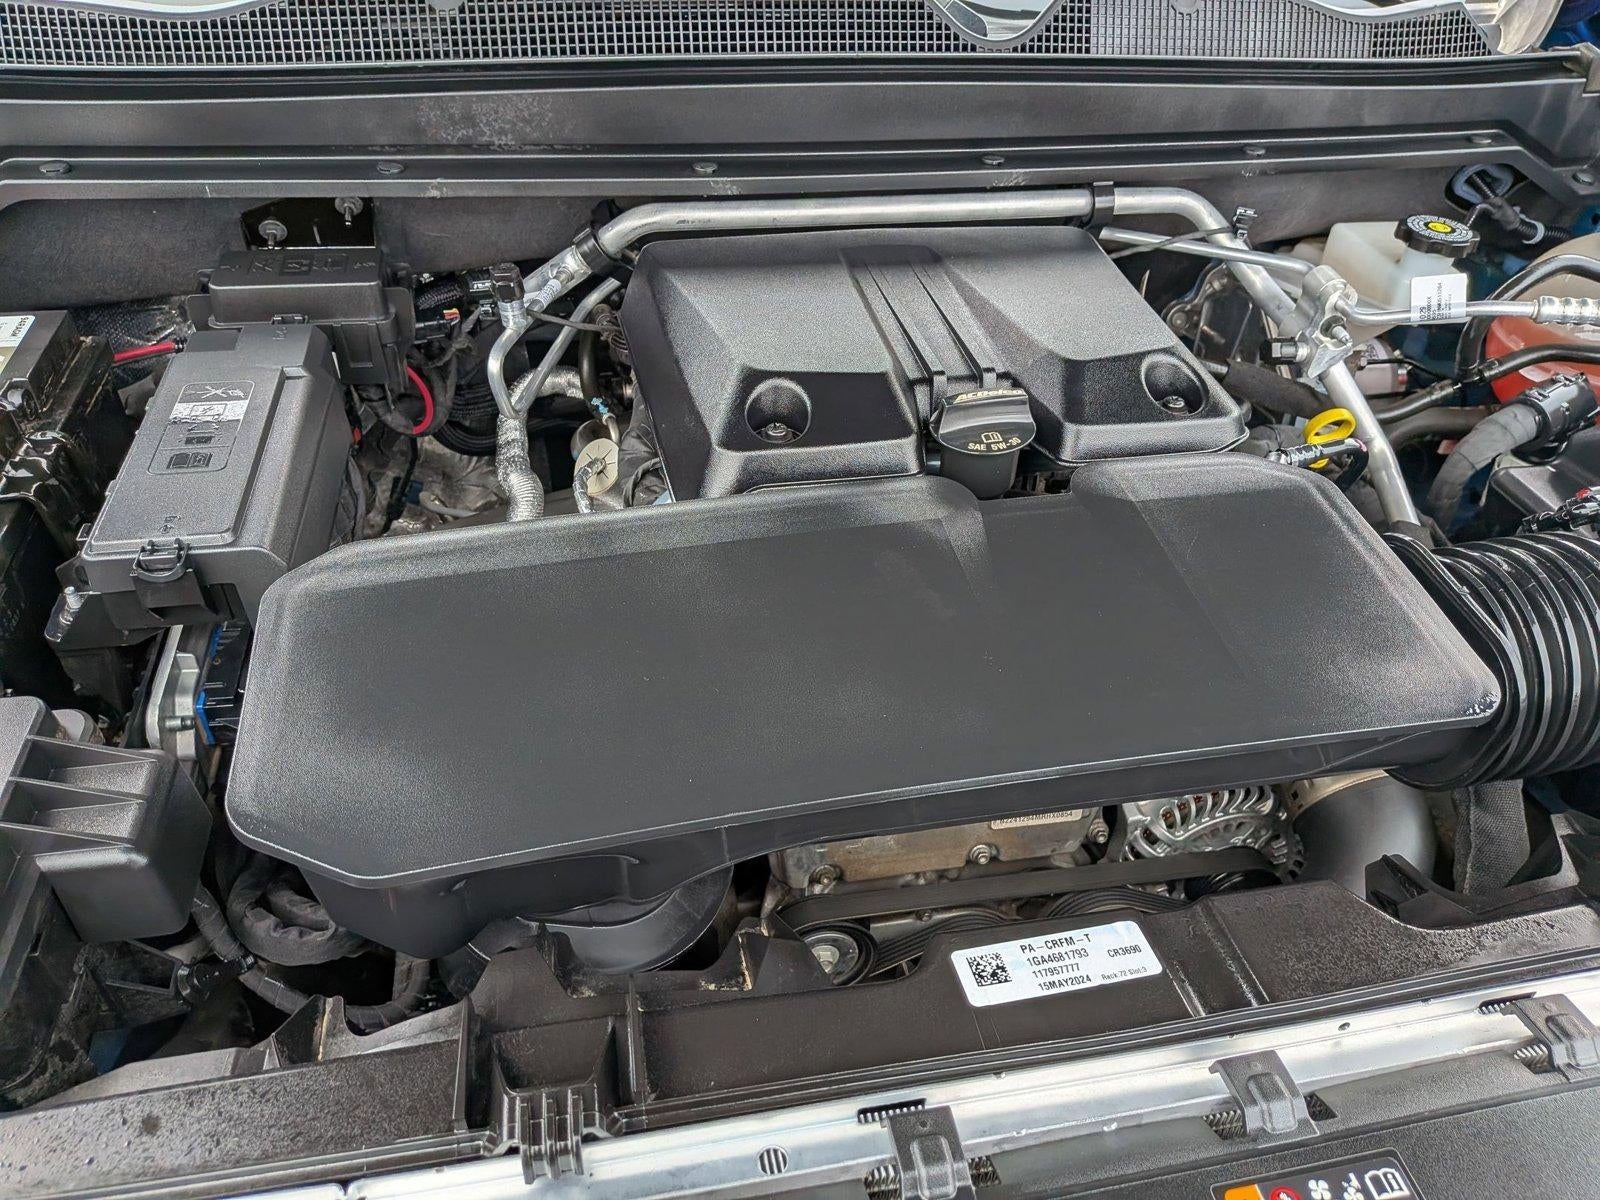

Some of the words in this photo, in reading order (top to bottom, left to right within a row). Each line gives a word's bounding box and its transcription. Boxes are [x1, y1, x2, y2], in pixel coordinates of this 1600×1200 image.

[967, 442, 988, 451] SAE
[990, 437, 1022, 451] 5W-30
[1026, 947, 1090, 967] 1GA4681793
[1107, 944, 1142, 958] CR3690
[1032, 962, 1081, 979] 117957777
[1038, 974, 1092, 992] 15MAY2024
